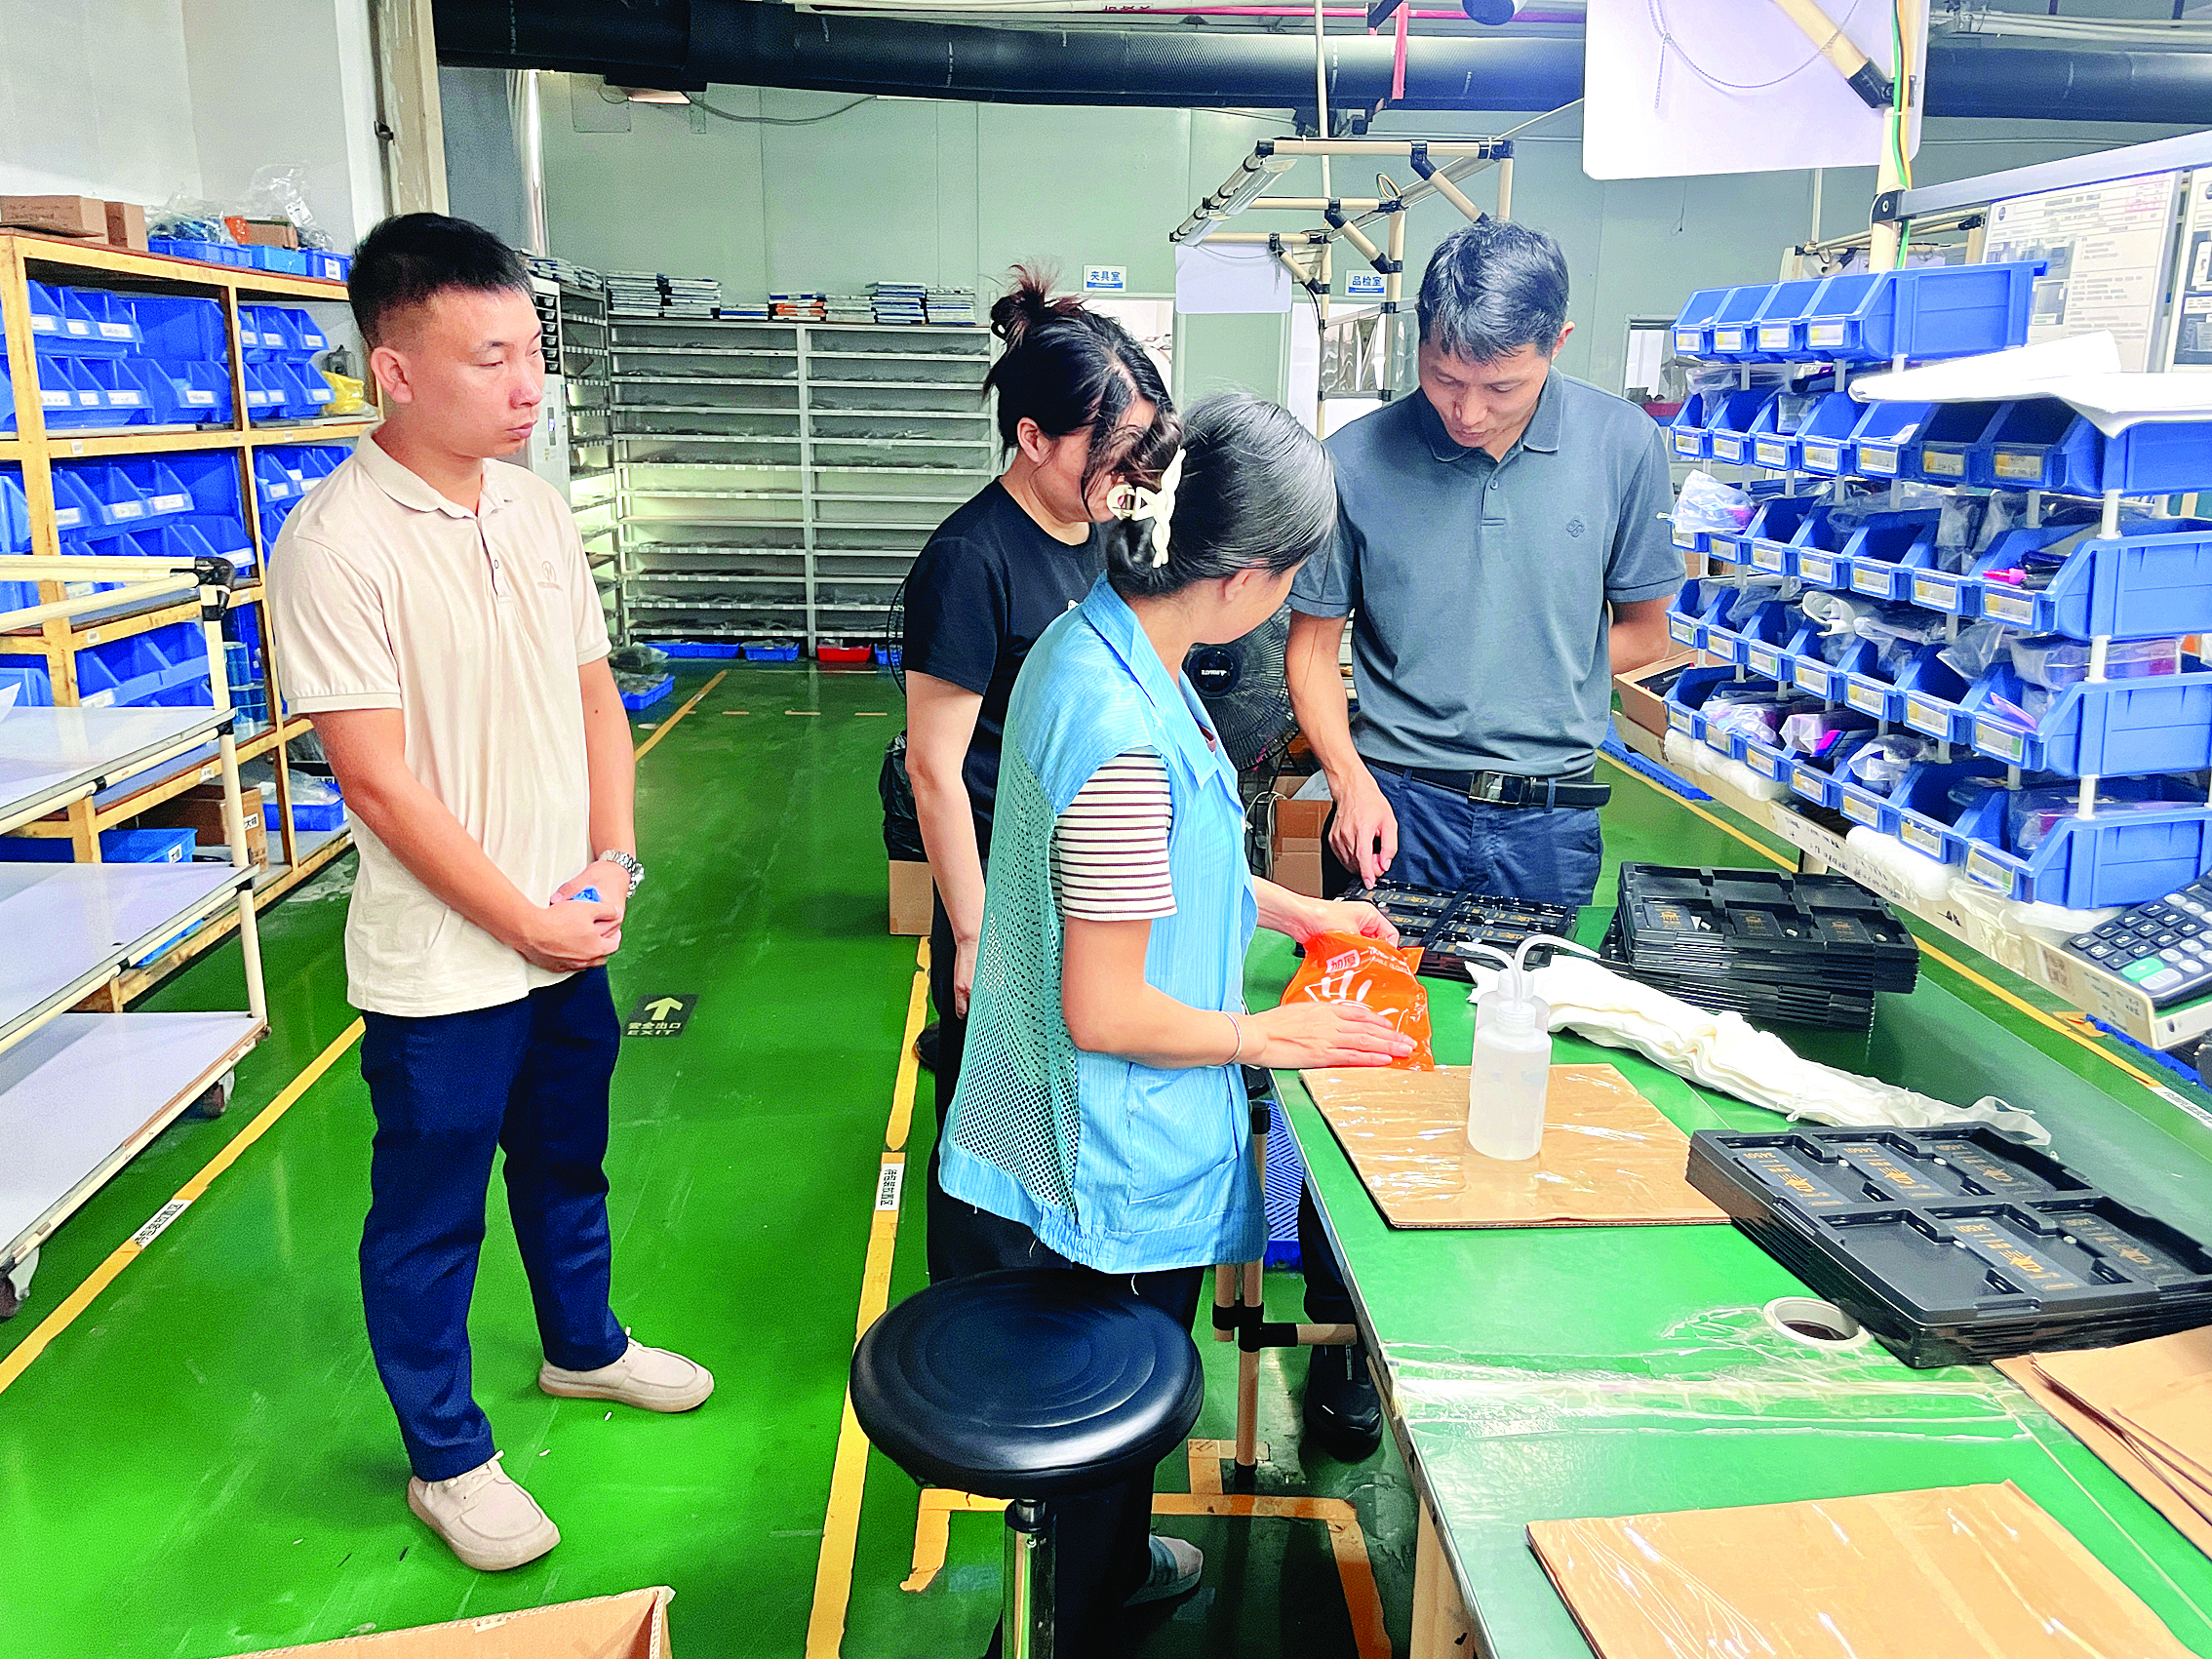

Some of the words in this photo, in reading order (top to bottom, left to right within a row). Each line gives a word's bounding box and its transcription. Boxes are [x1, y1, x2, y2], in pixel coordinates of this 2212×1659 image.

[1090, 270, 1121, 282] 夹具室
[1352, 275, 1382, 287] 品检室
[2090, 945, 2108, 955] 00
[1330, 953, 1356, 970] 加厚
